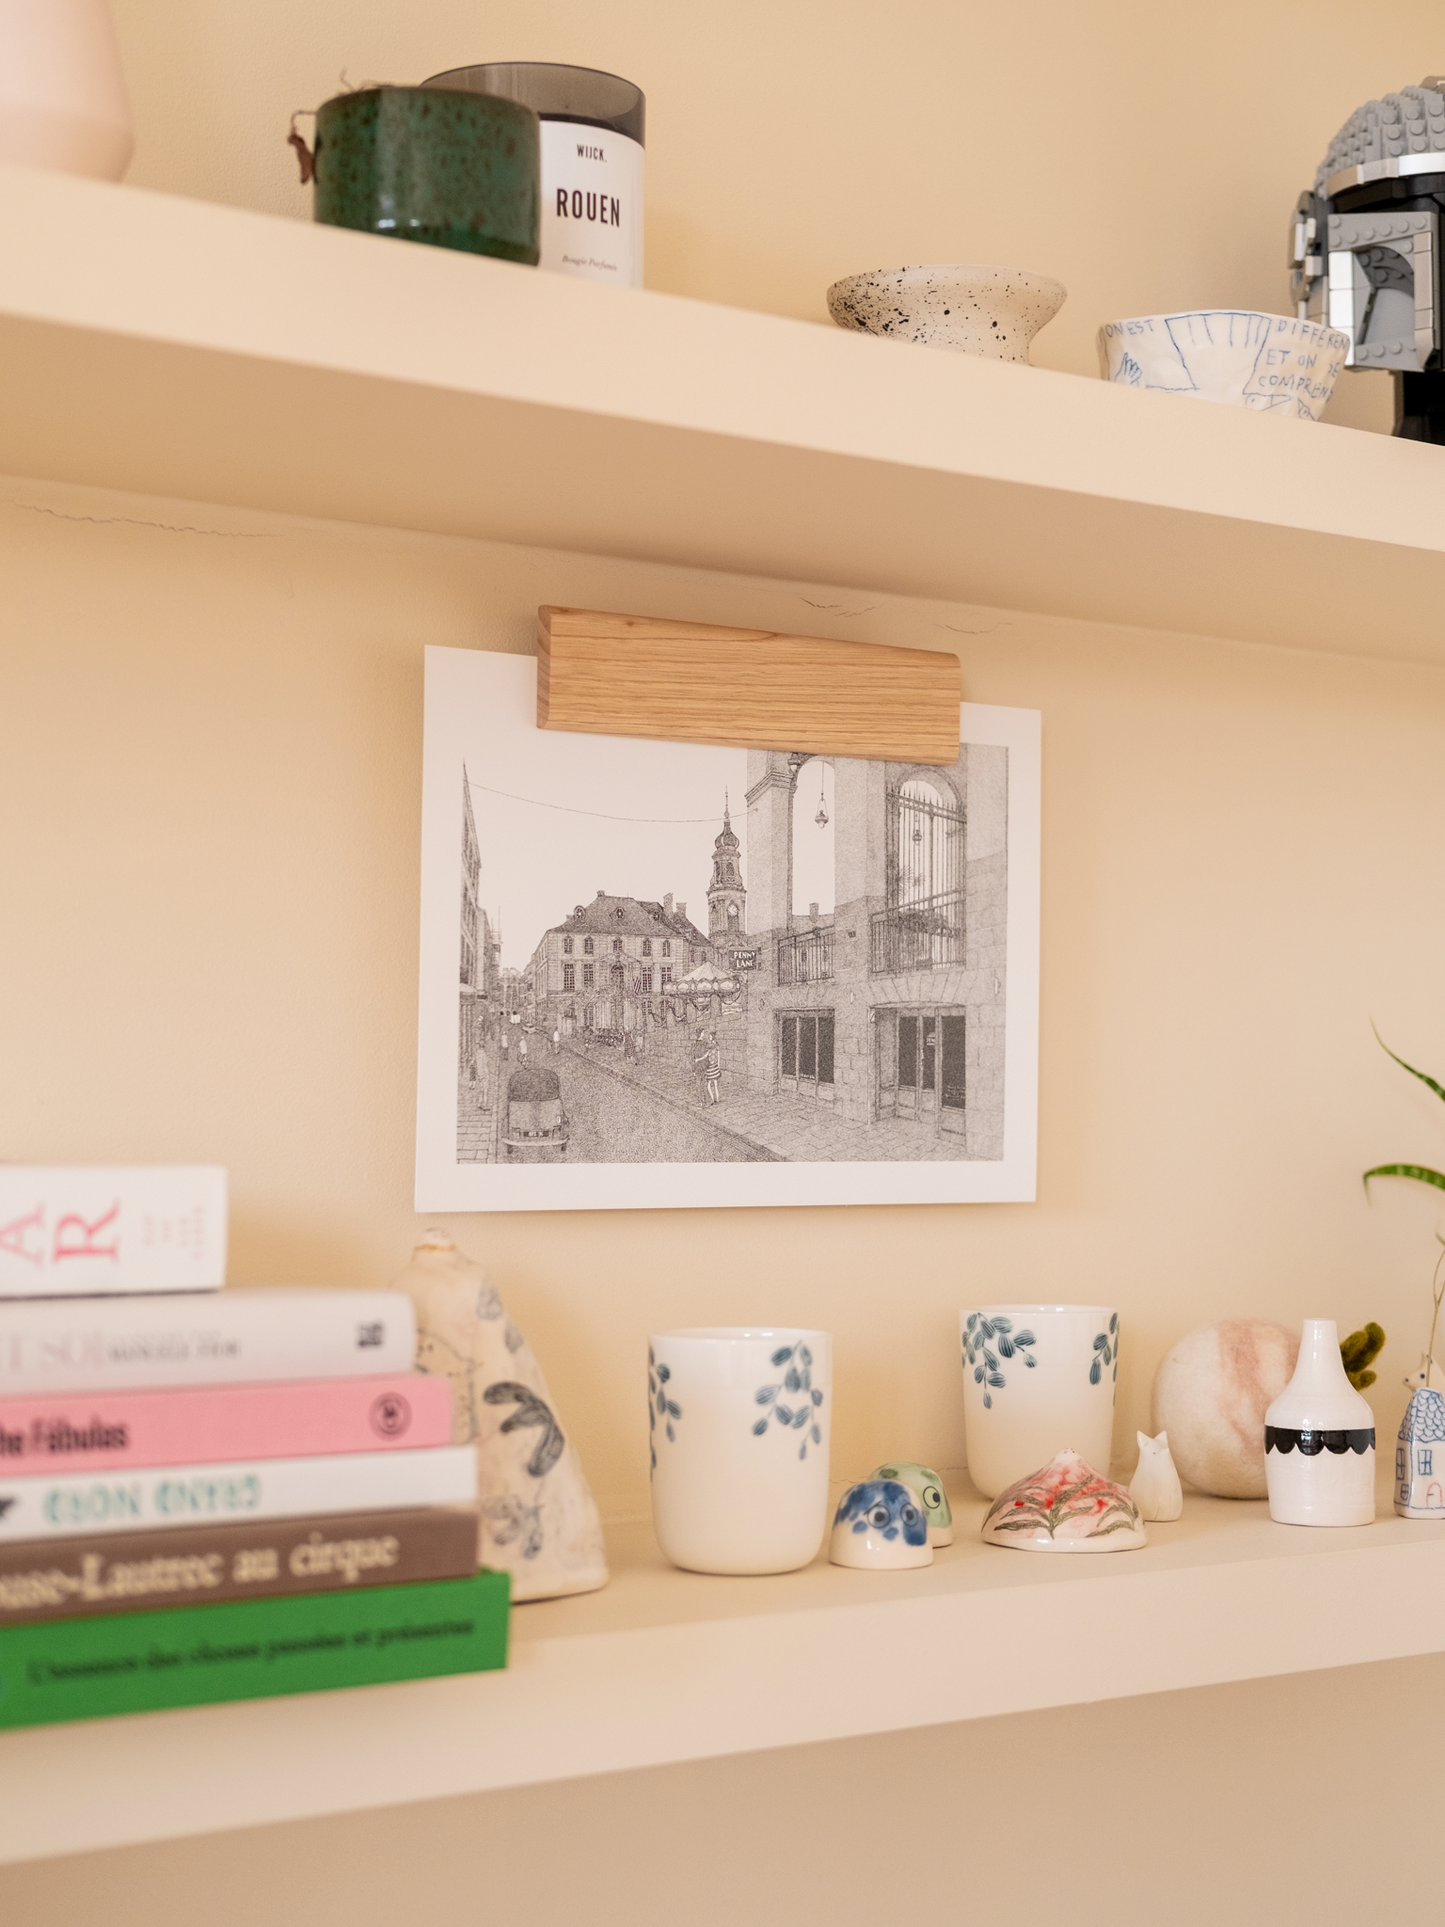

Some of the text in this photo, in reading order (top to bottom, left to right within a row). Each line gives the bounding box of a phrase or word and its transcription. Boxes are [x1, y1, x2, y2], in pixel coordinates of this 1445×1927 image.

[576, 144, 608, 163] WIJCK.
[556, 188, 620, 228] ROUEN
[1266, 349, 1291, 365] ET
[1297, 353, 1317, 369] ON
[733, 951, 756, 959] PENNY
[232, 1548, 279, 1583] au
[289, 1532, 400, 1584] cirque
